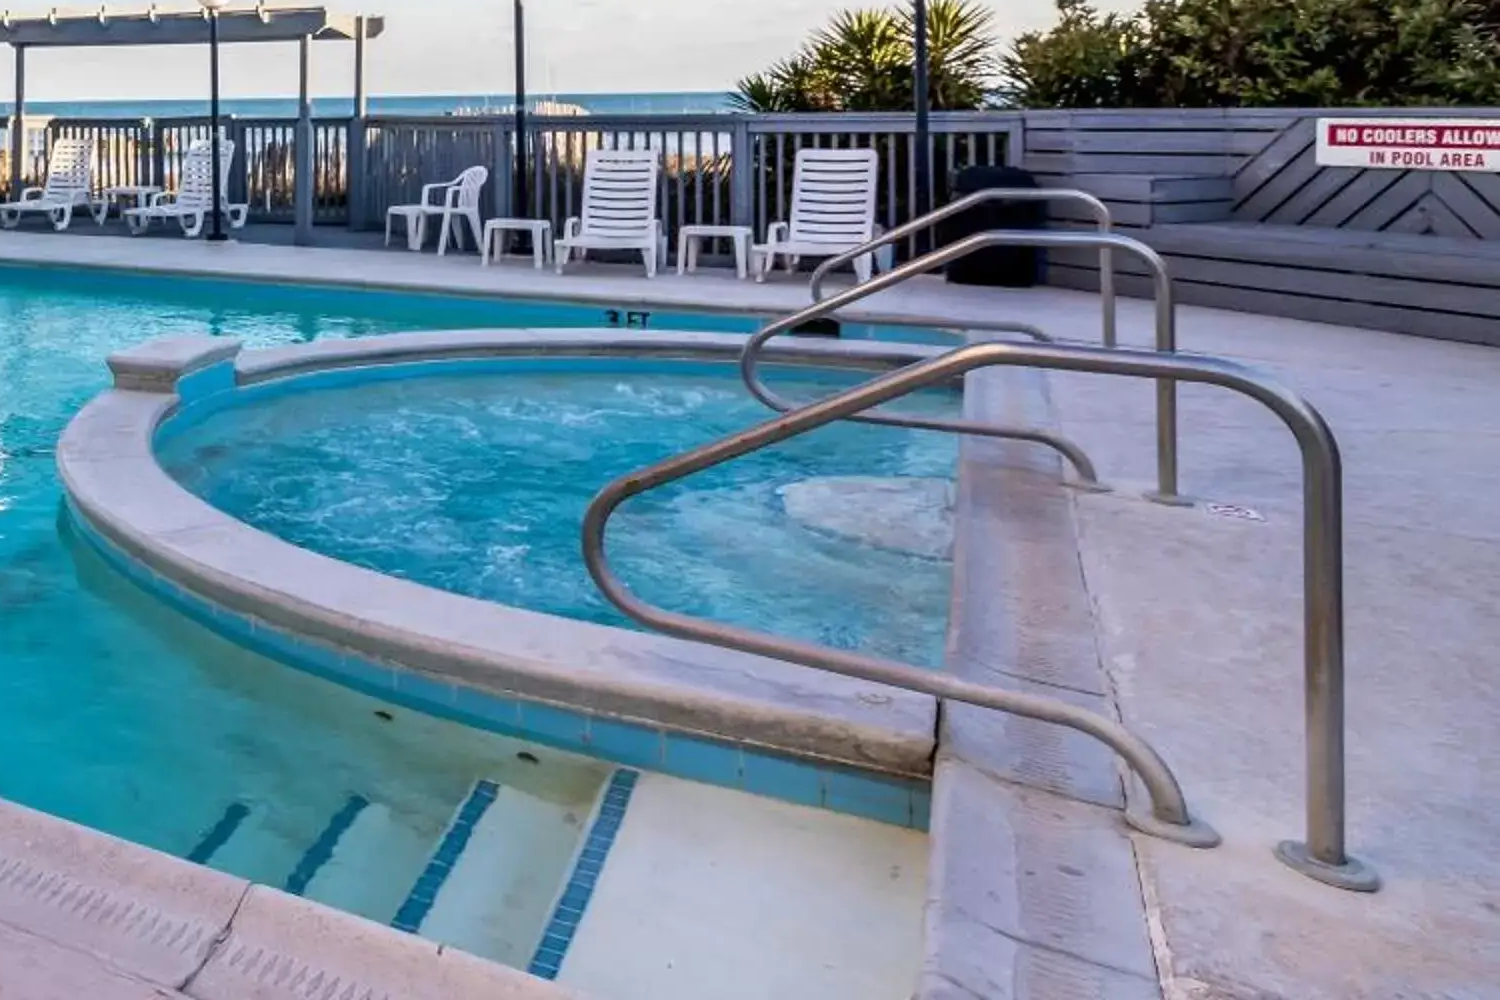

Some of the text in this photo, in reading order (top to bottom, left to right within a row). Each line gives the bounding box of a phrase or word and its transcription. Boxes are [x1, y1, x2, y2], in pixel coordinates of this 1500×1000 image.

[1336, 128, 1357, 142] NO
[1362, 129, 1438, 145] COOLERS
[1369, 151, 1485, 168] IN POOL AREA
